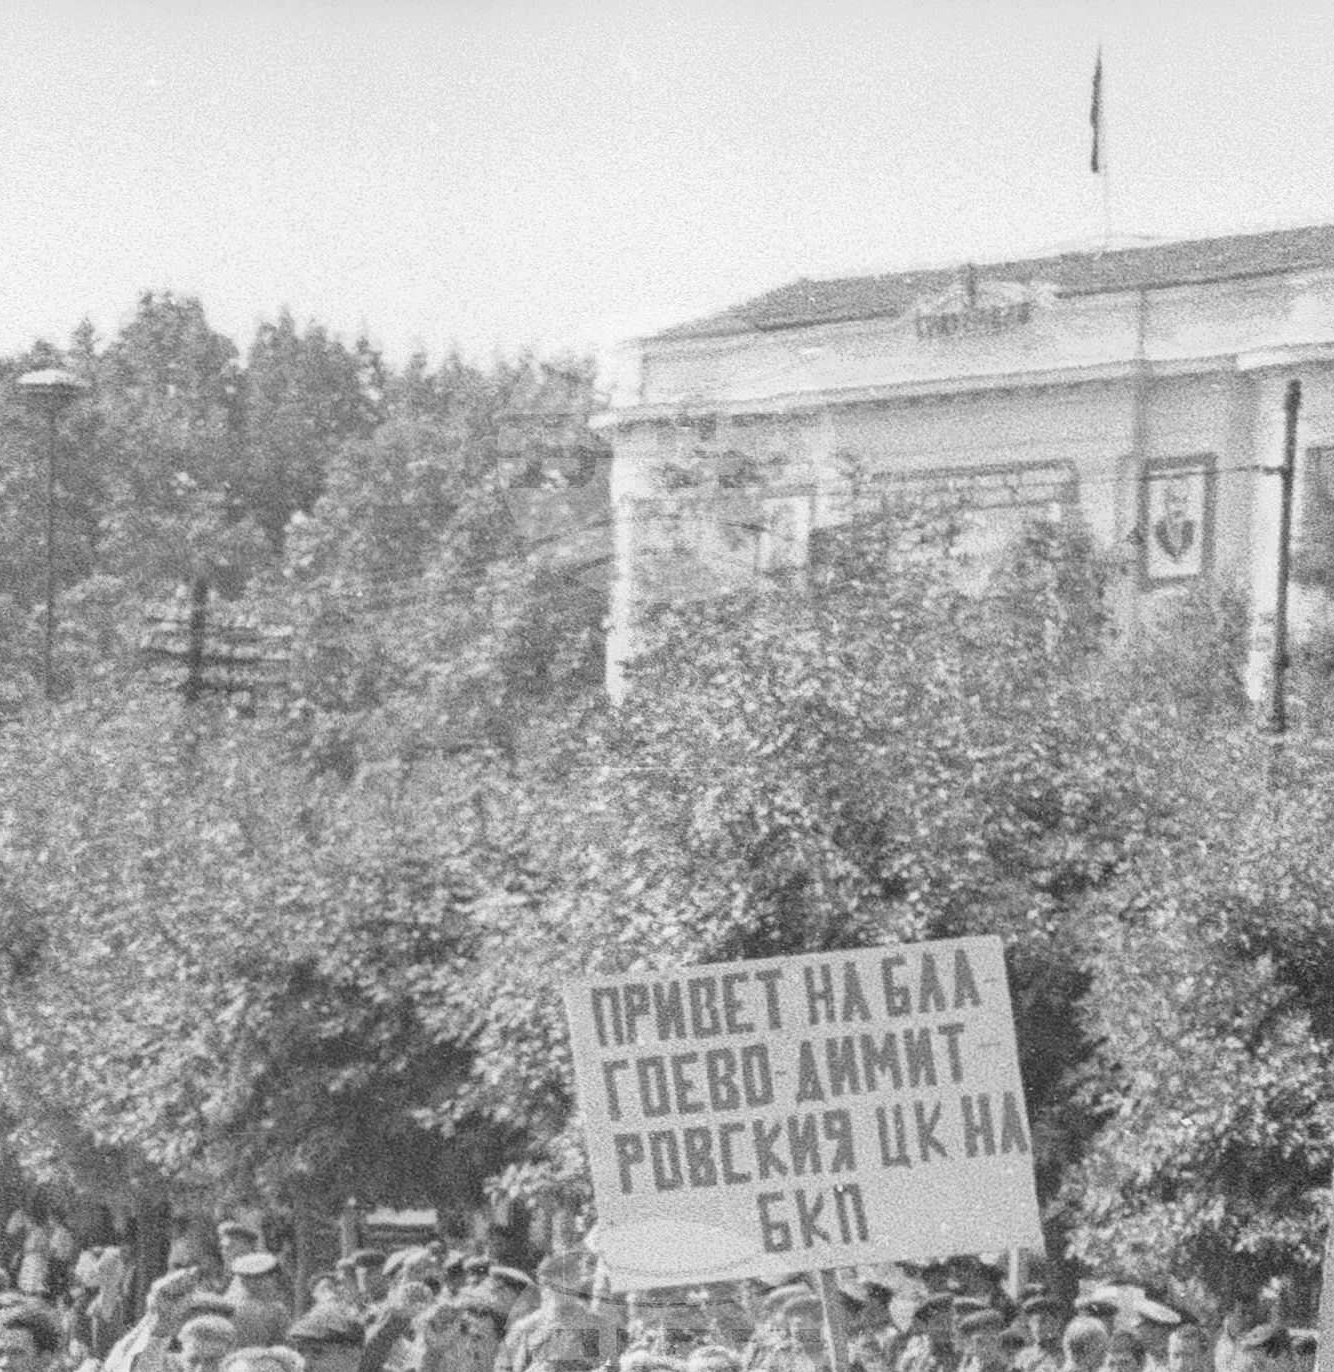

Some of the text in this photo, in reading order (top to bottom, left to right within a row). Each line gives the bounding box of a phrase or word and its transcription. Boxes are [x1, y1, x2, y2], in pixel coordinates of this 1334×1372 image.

[591, 968, 783, 1047] ПРИВЕТ
[803, 961, 872, 1026] НА
[614, 1092, 1027, 1194] РОВСКИЯ ЦК НА
[757, 1183, 869, 1253] БКП
